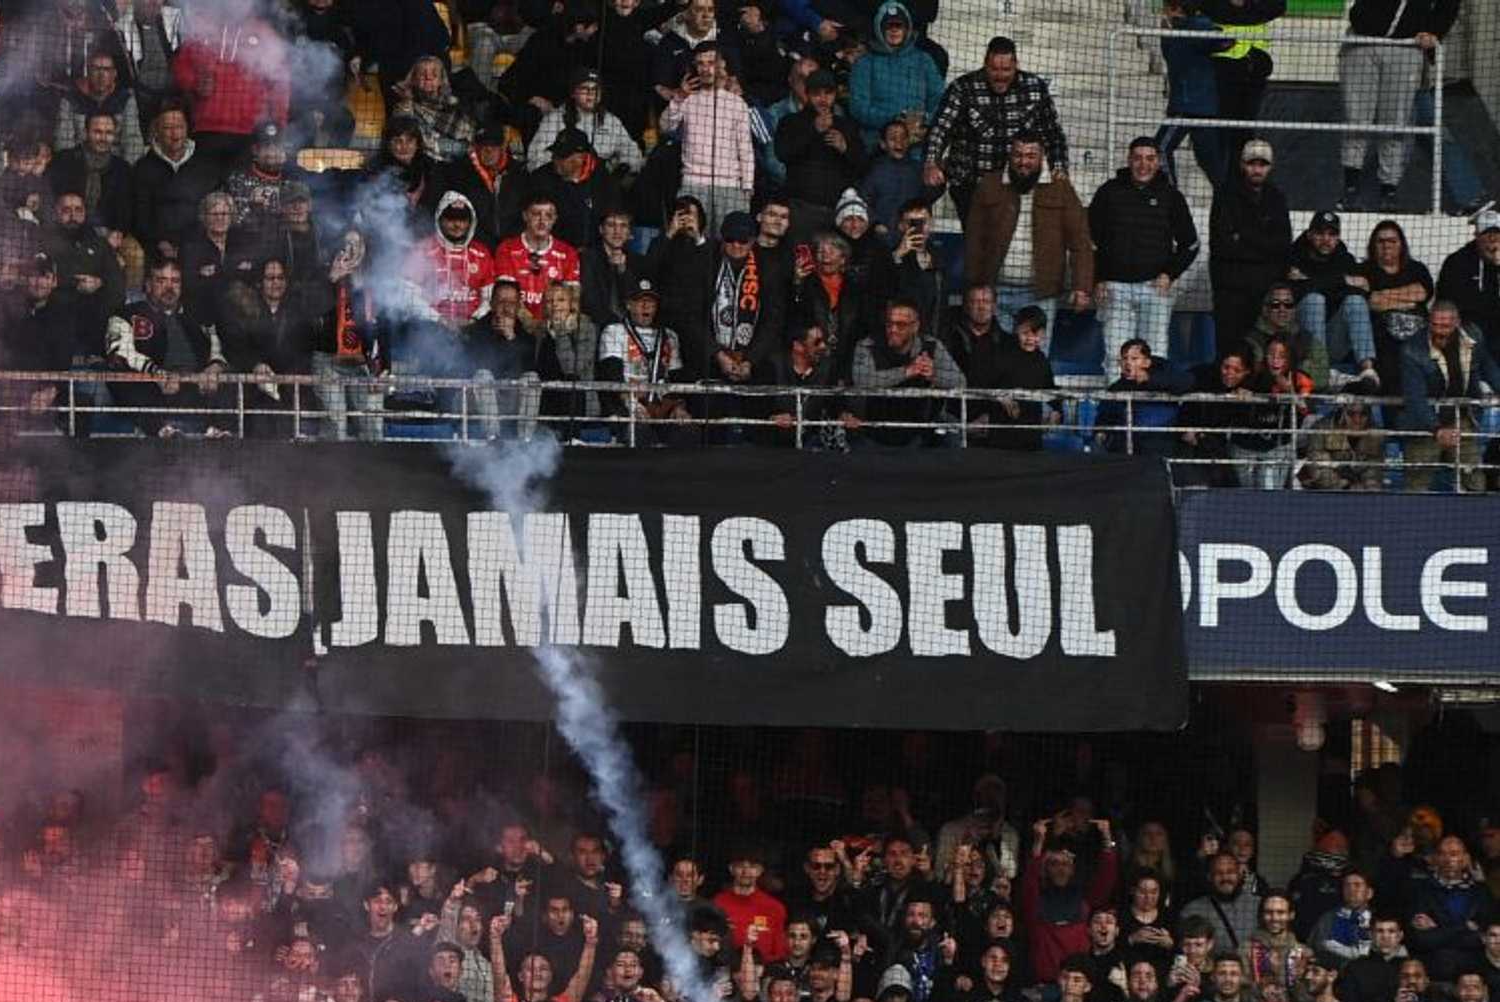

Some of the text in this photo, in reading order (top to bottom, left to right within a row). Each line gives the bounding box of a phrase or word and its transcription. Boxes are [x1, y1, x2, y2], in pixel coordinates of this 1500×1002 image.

[331, 510, 791, 656] JAMAIS
[821, 518, 1116, 659] SEUL
[1178, 542, 1488, 632] POLE
